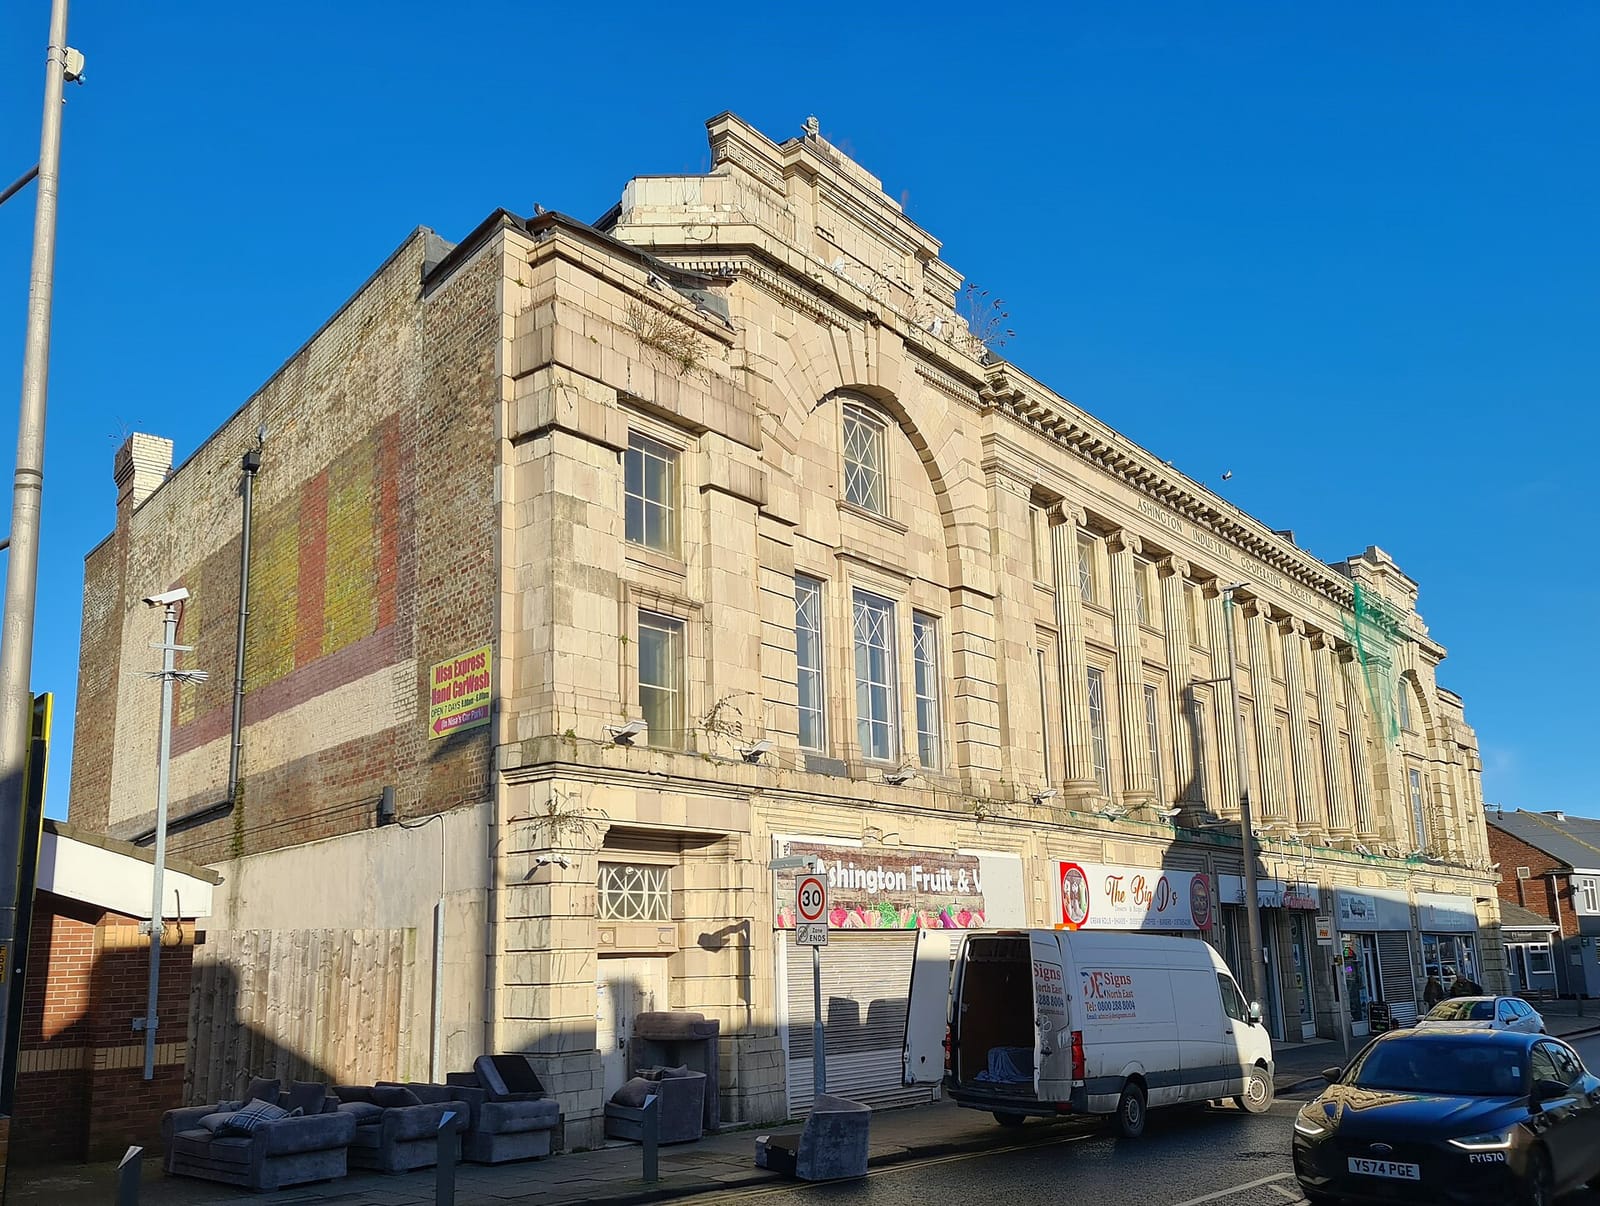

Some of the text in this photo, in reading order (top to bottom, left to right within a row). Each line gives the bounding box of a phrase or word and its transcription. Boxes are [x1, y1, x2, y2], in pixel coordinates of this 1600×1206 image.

[1137, 498, 1183, 533] ASHINGTON
[1192, 528, 1232, 560] INDUSTRIAL
[1240, 557, 1283, 588] CO-OPERATIVE
[435, 652, 486, 685] Nisa Express
[431, 682, 452, 706] Hand
[431, 707, 444, 718] OPEN
[814, 858, 906, 894] Ashington
[911, 865, 953, 892] Fruit
[957, 868, 970, 893] &
[802, 890, 821, 907] 30
[1104, 875, 1126, 906] The
[1130, 874, 1152, 911] Big
[809, 934, 826, 942] ENDS
[1103, 972, 1132, 988] Signs
[1106, 989, 1134, 999] North East
[1085, 1001, 1097, 1012] Tel:
[1097, 1001, 1112, 1012] 0800
[1353, 1160, 1414, 1177] YS74 PGE
